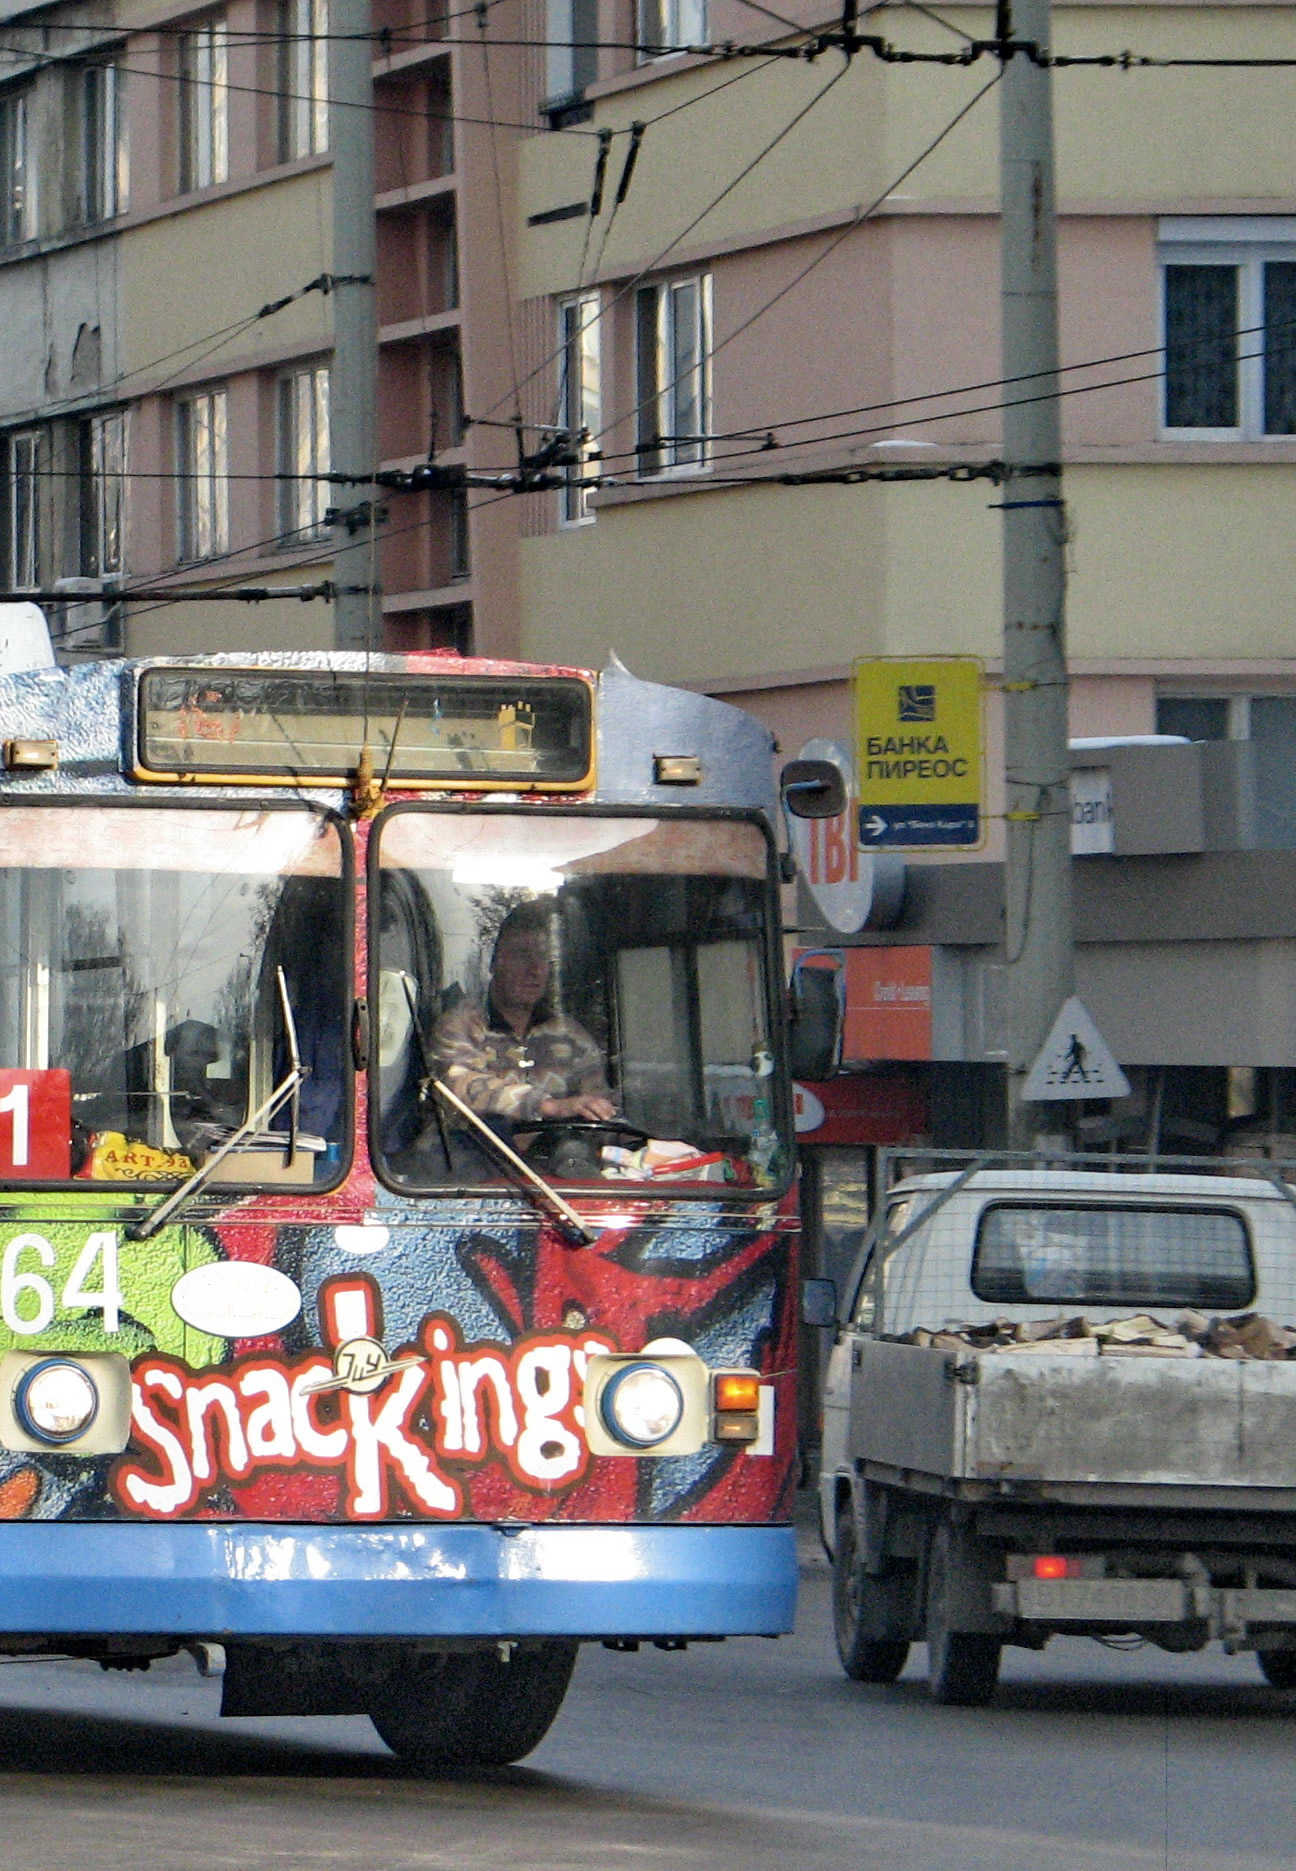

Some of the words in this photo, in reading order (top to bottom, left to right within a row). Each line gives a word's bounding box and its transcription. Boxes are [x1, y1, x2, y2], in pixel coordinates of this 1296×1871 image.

[867, 736, 949, 756] БАНКА
[867, 759, 968, 780] ПИРЕОС
[0, 1085, 29, 1166] 1
[105, 1150, 155, 1168] ART
